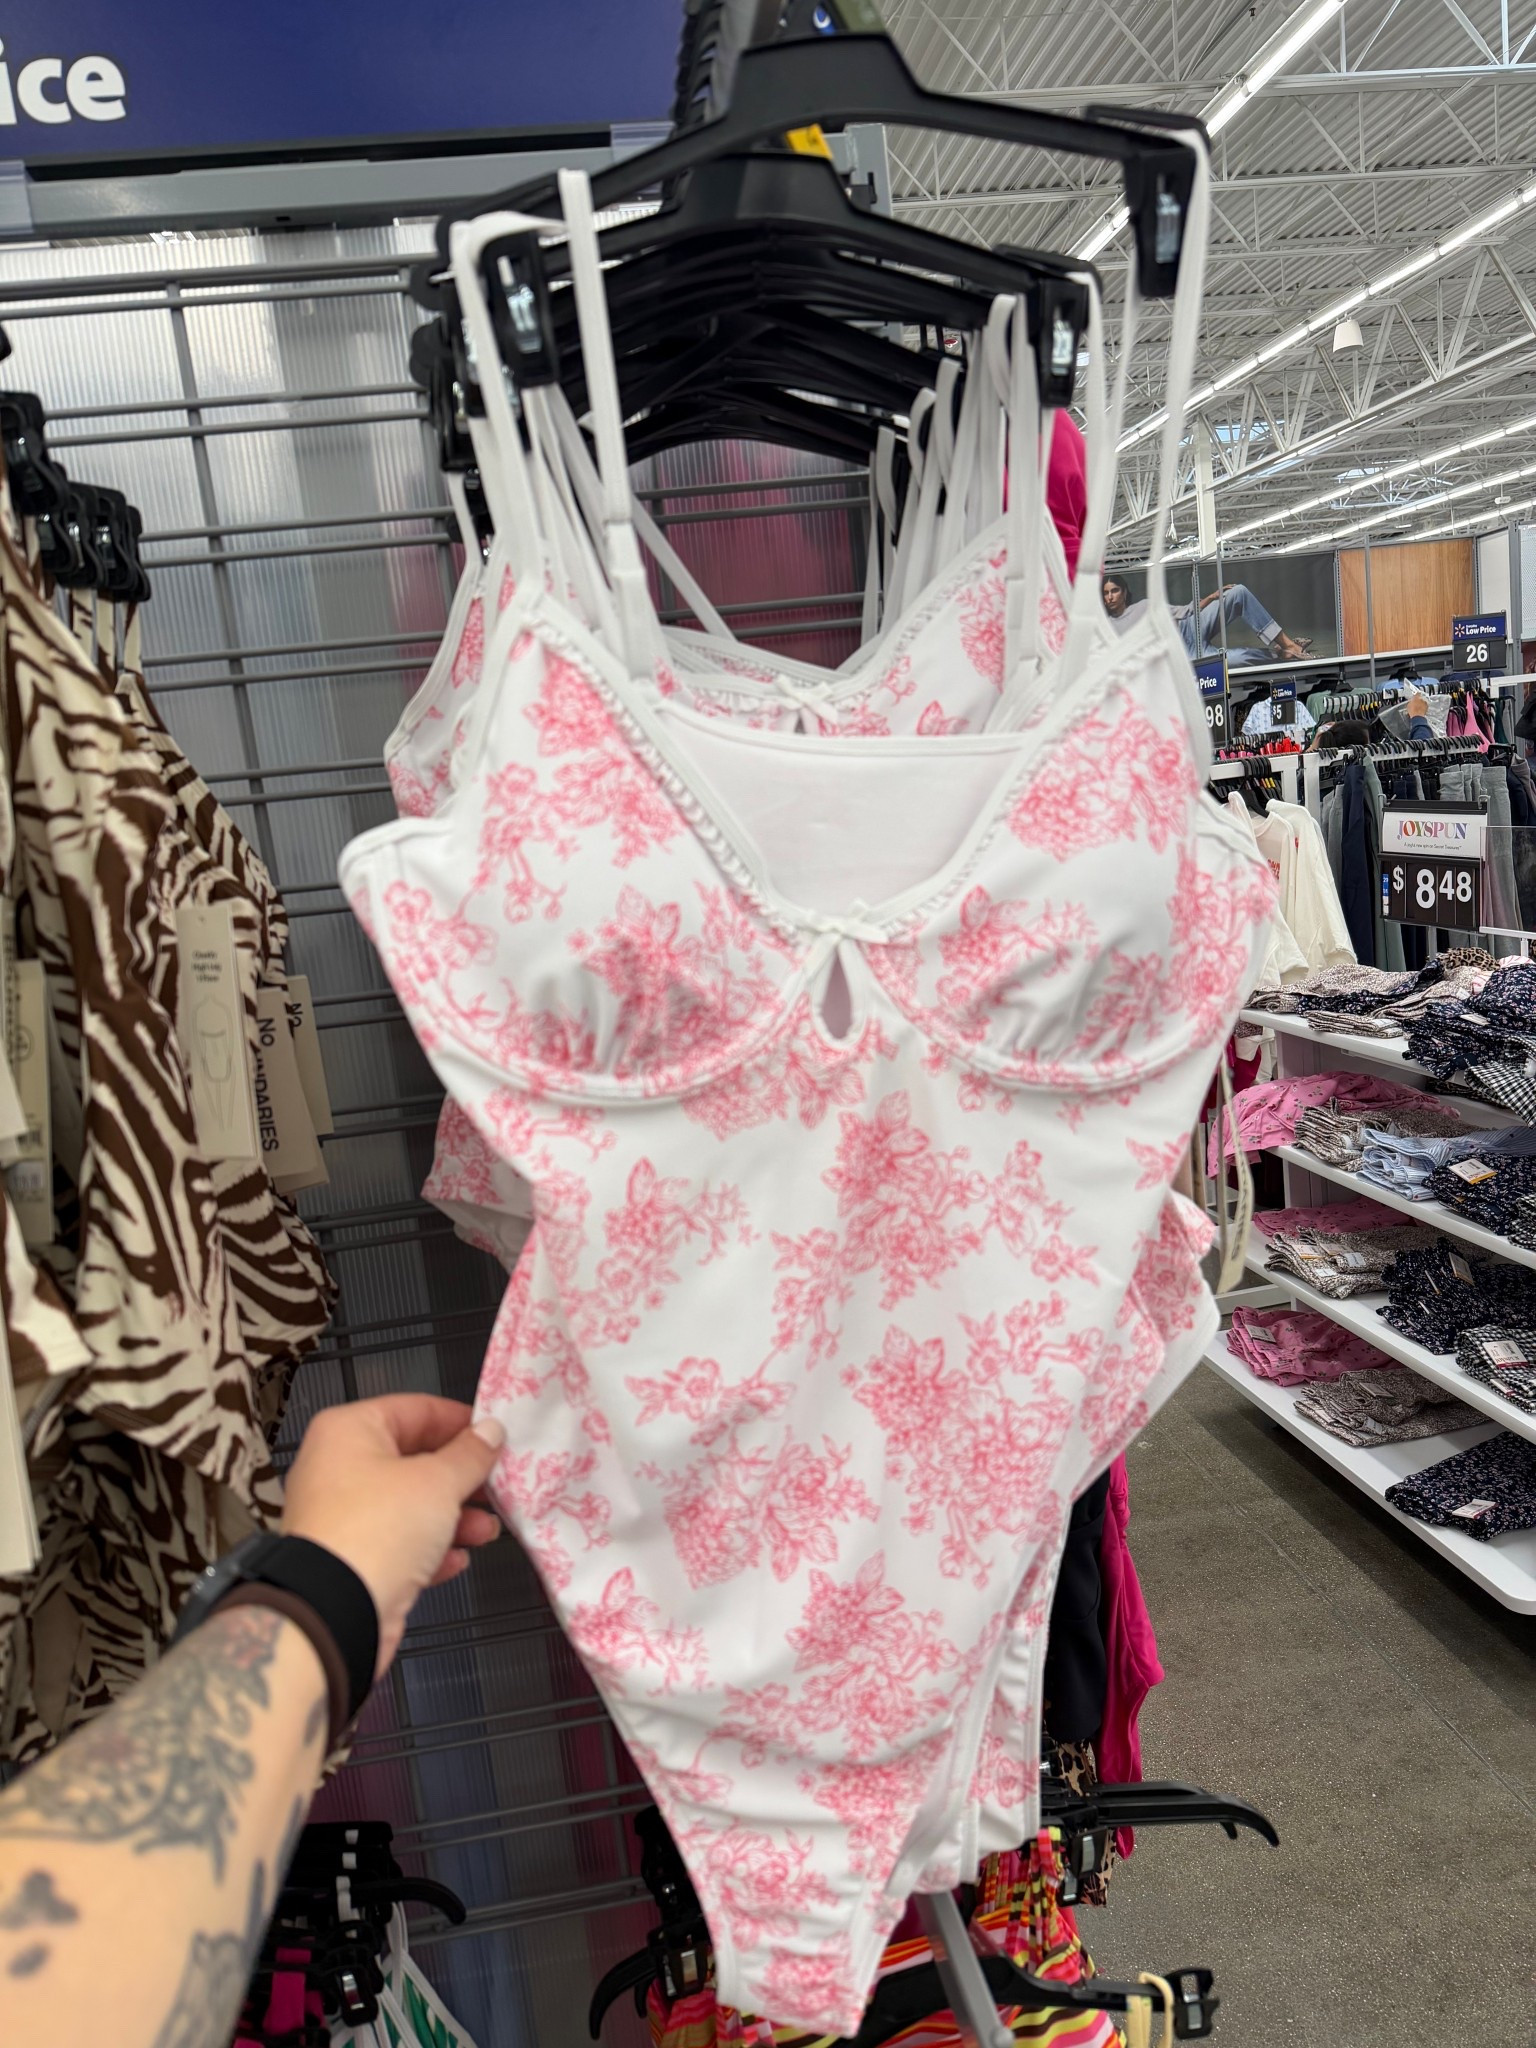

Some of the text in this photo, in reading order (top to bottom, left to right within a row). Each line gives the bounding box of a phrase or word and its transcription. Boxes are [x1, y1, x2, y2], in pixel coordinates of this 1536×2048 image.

[1466, 627, 1480, 635] Low
[1480, 625, 1497, 634] Price
[1466, 643, 1488, 664] 26
[1200, 676, 1217, 689] Price
[1205, 704, 1224, 728] 98
[1397, 820, 1469, 840] JOYSPUN
[257, 1018, 277, 1047] NO
